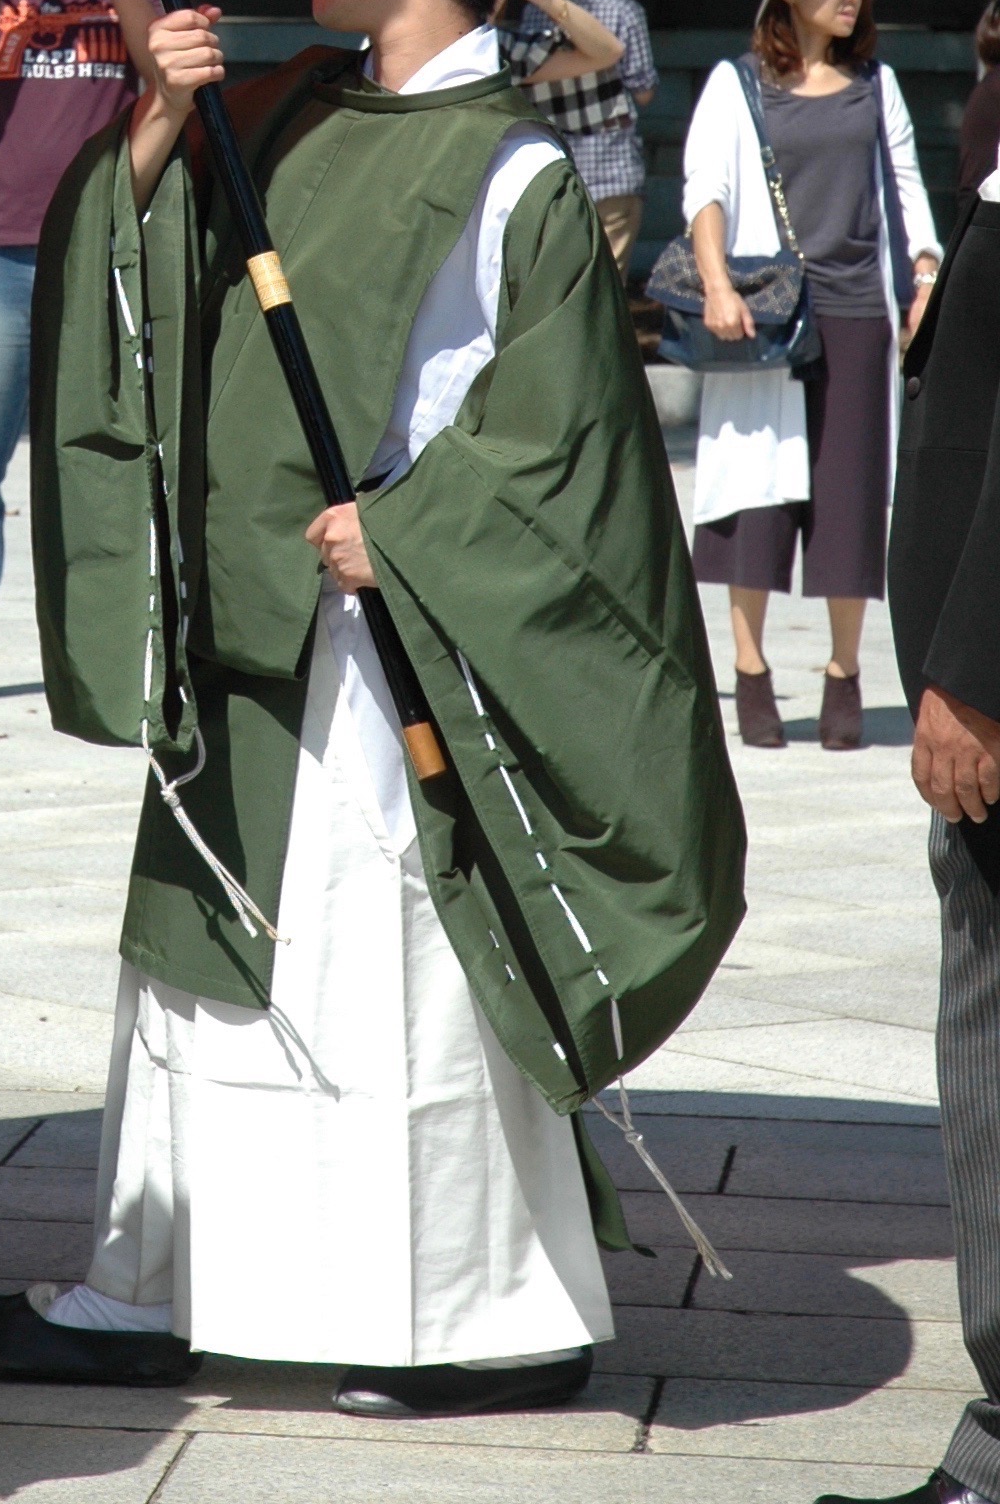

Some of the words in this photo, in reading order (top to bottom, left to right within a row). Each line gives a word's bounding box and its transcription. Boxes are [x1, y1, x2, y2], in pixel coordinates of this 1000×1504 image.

[23, 48, 76, 64] LAPD
[21, 63, 75, 79] RULES
[77, 62, 126, 79] HERE
